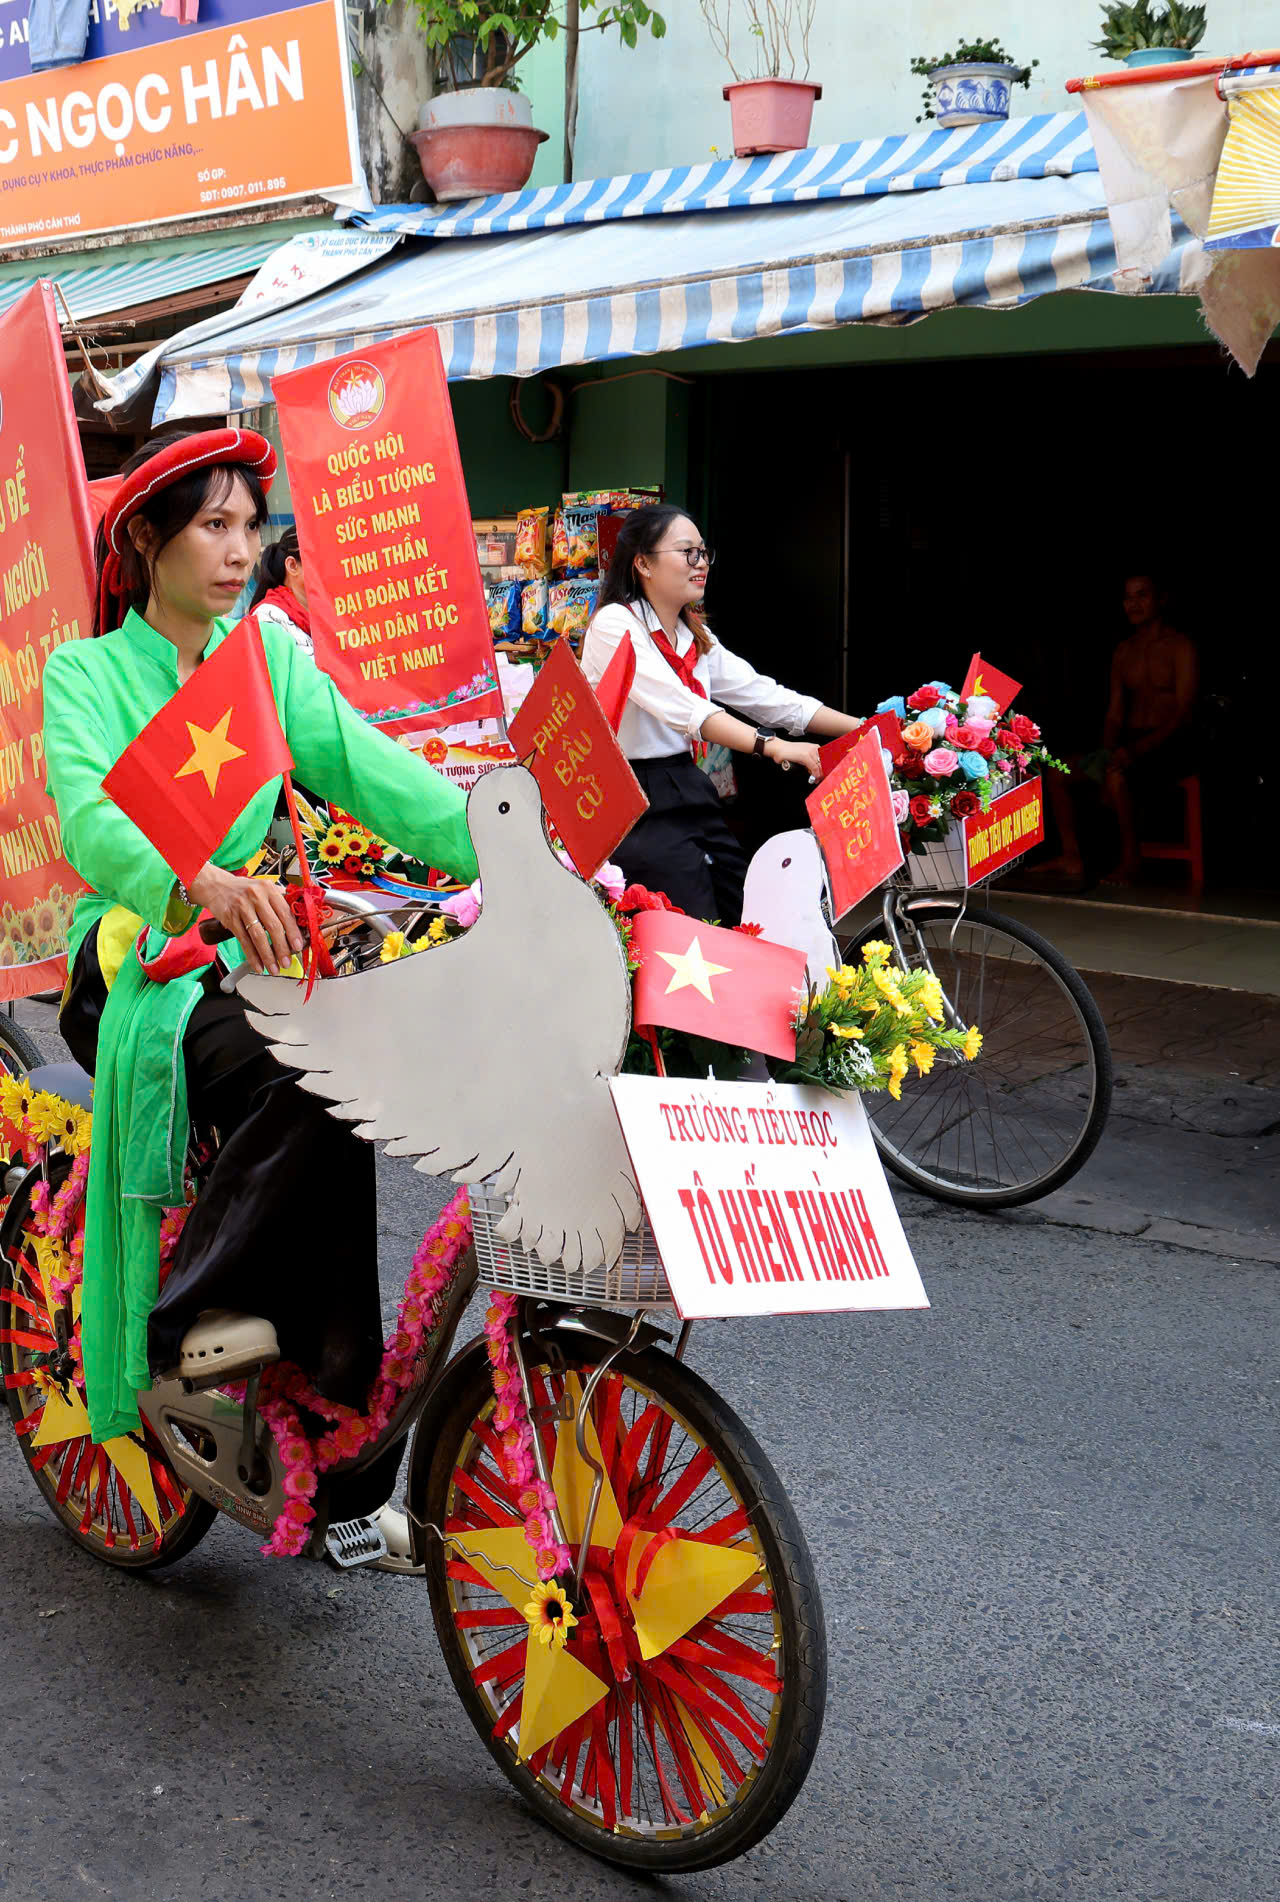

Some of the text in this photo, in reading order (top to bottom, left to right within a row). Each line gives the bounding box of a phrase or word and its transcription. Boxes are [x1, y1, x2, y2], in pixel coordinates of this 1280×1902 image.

[25, 73, 171, 158] NGỌC
[180, 33, 304, 125] HÂN
[3, 174, 26, 192] DỤNG
[28, 173, 41, 187] CỤ
[42, 173, 49, 183] Y
[135, 148, 163, 166] CHỨC
[327, 431, 405, 477] QUỐC HỘI
[5, 443, 30, 525] ĐỂ
[312, 462, 437, 516] LÀ BIỂU TƯỢNG
[335, 502, 421, 545] SỨC MẠNH
[3, 540, 50, 618] NGƯỜI
[340, 532, 429, 579] TINH THẦN
[334, 562, 449, 618] ĐẠI ĐOÀN KẾT
[335, 601, 460, 651] TOÀN DÂN TỘC
[16, 631, 40, 695] CÓ
[359, 643, 446, 681] VIỆT NAM!
[532, 682, 579, 756] PHIẾU
[445, 764, 476, 778] TƯỢNG
[552, 724, 594, 788] BẦU
[574, 772, 607, 822] CỬ
[819, 758, 872, 818] PHIẾU
[837, 781, 878, 830] BẦU
[0, 813, 50, 880] NHÂN
[845, 819, 873, 862] CỬ
[659, 1090, 838, 1159] TRƯỜNG TIỂU HỌC
[677, 1162, 890, 1286] TÔ HIẾN THÀNH
